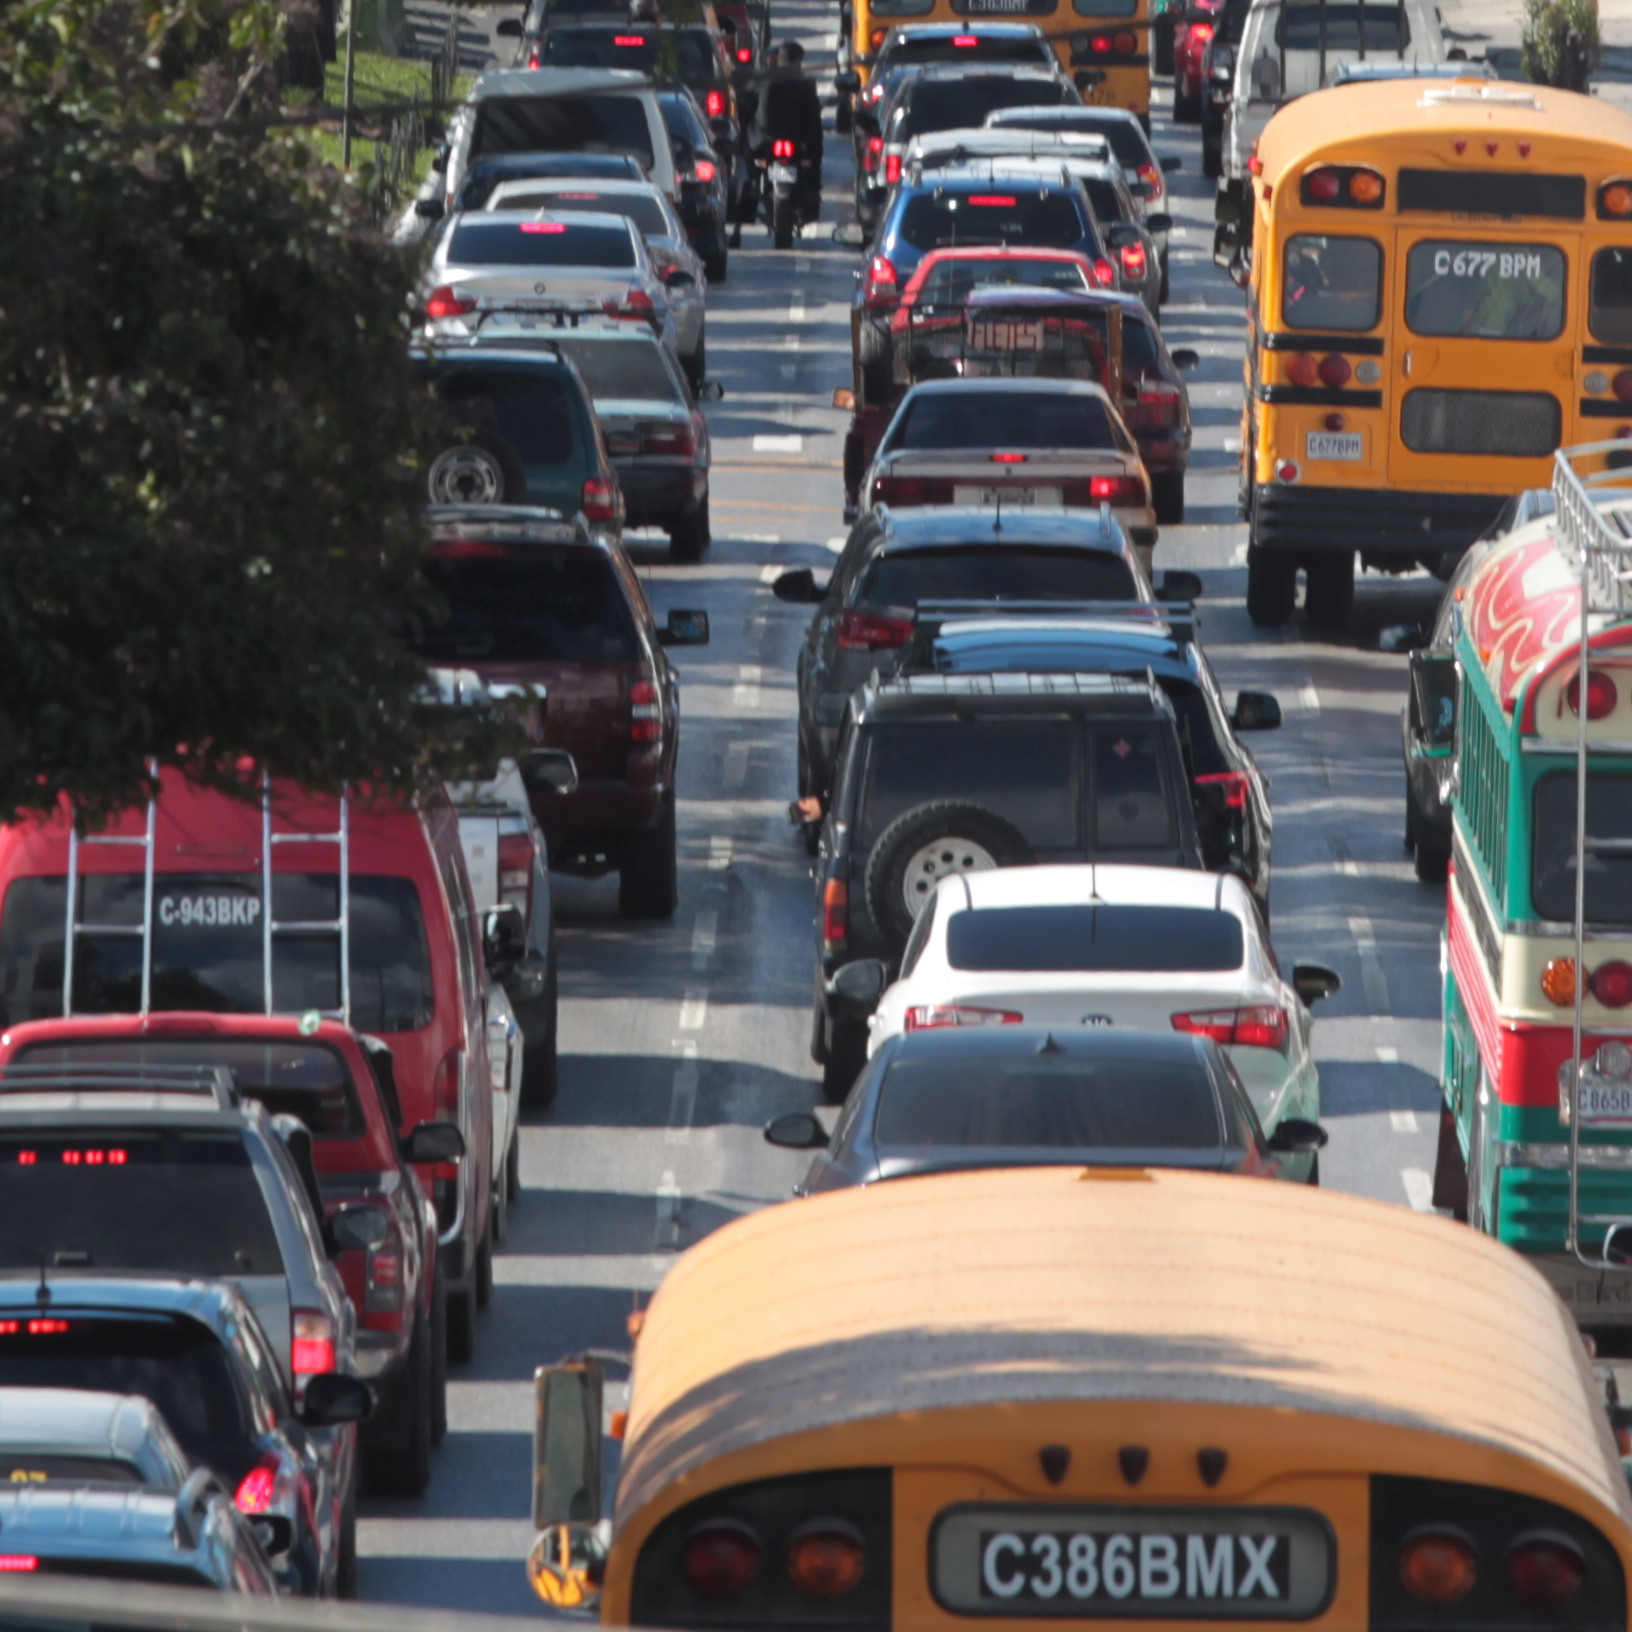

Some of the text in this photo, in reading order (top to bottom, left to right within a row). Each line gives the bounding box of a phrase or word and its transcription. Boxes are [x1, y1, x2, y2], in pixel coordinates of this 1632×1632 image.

[1434, 249, 1542, 280] C 677 BPM
[158, 895, 261, 928] C-943BKP
[980, 1531, 1285, 1600] C386BMX
